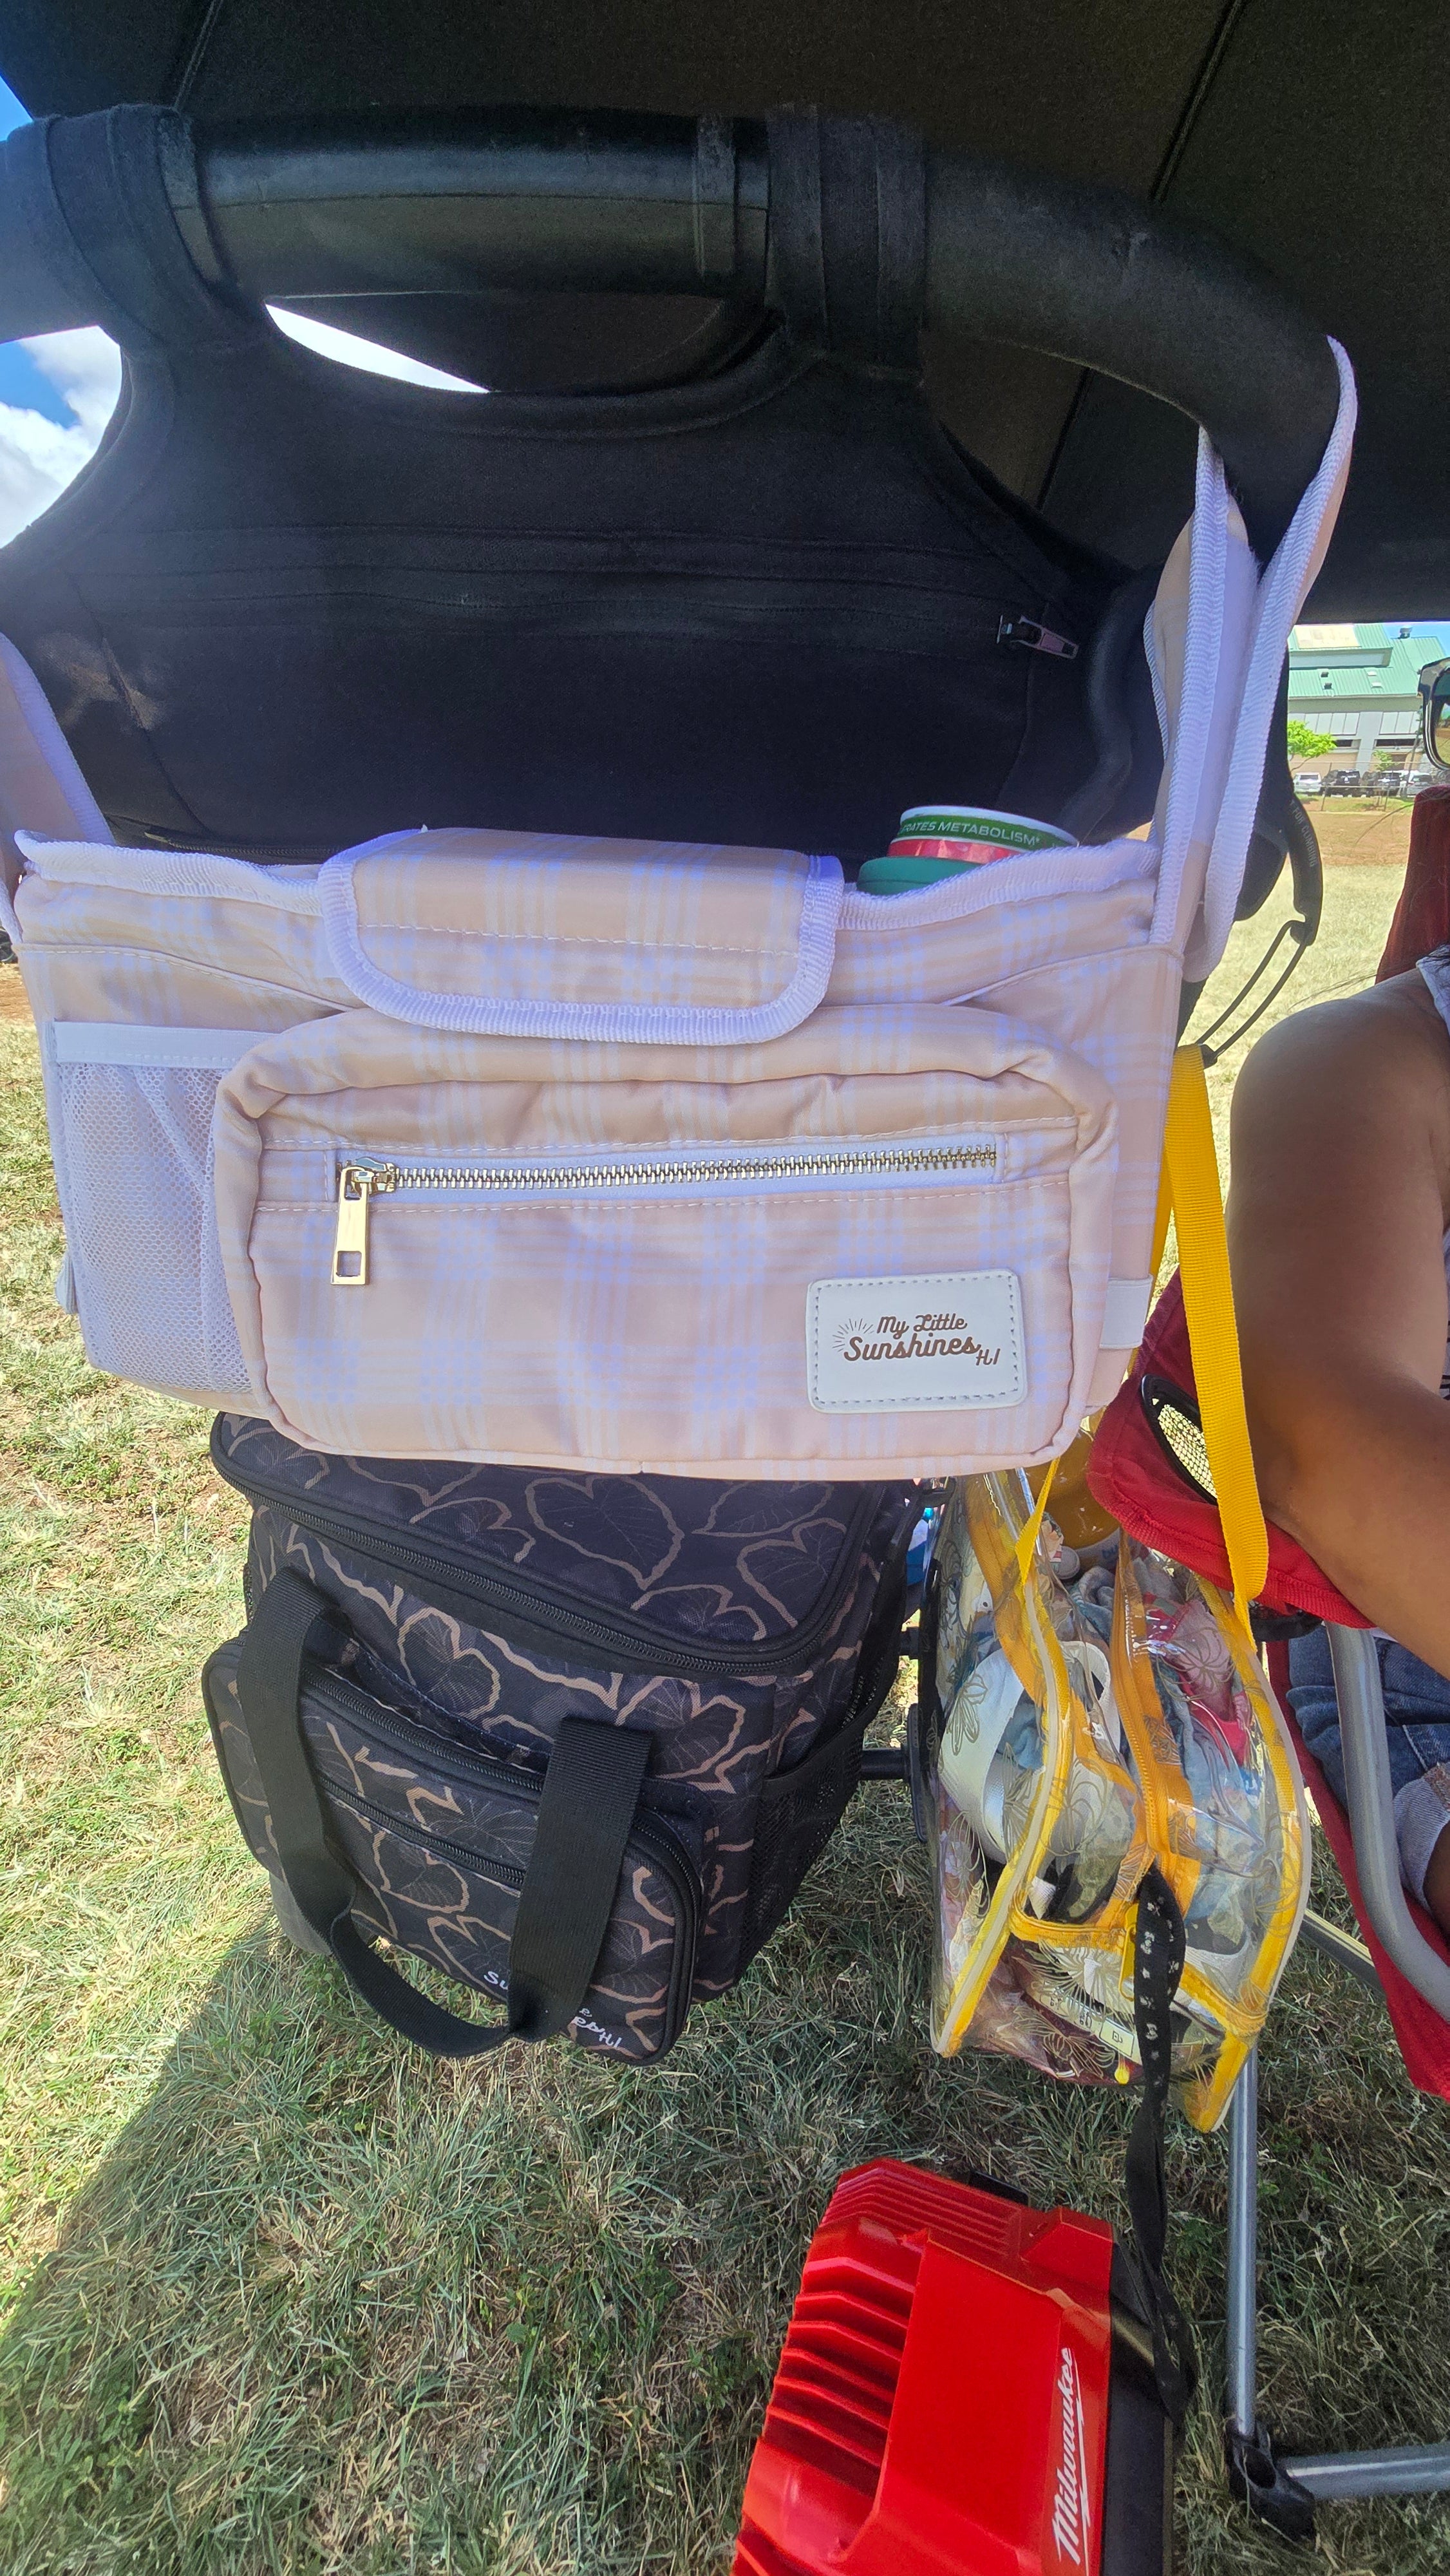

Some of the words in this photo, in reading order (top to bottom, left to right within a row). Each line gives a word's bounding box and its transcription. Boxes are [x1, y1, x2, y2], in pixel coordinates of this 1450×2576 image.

[876, 1315, 910, 1340] My
[913, 1312, 968, 1332] Little
[843, 1332, 982, 1362] Sunshines
[975, 1347, 1001, 1367] HI
[1051, 2347, 1081, 2566] Milwaukee
